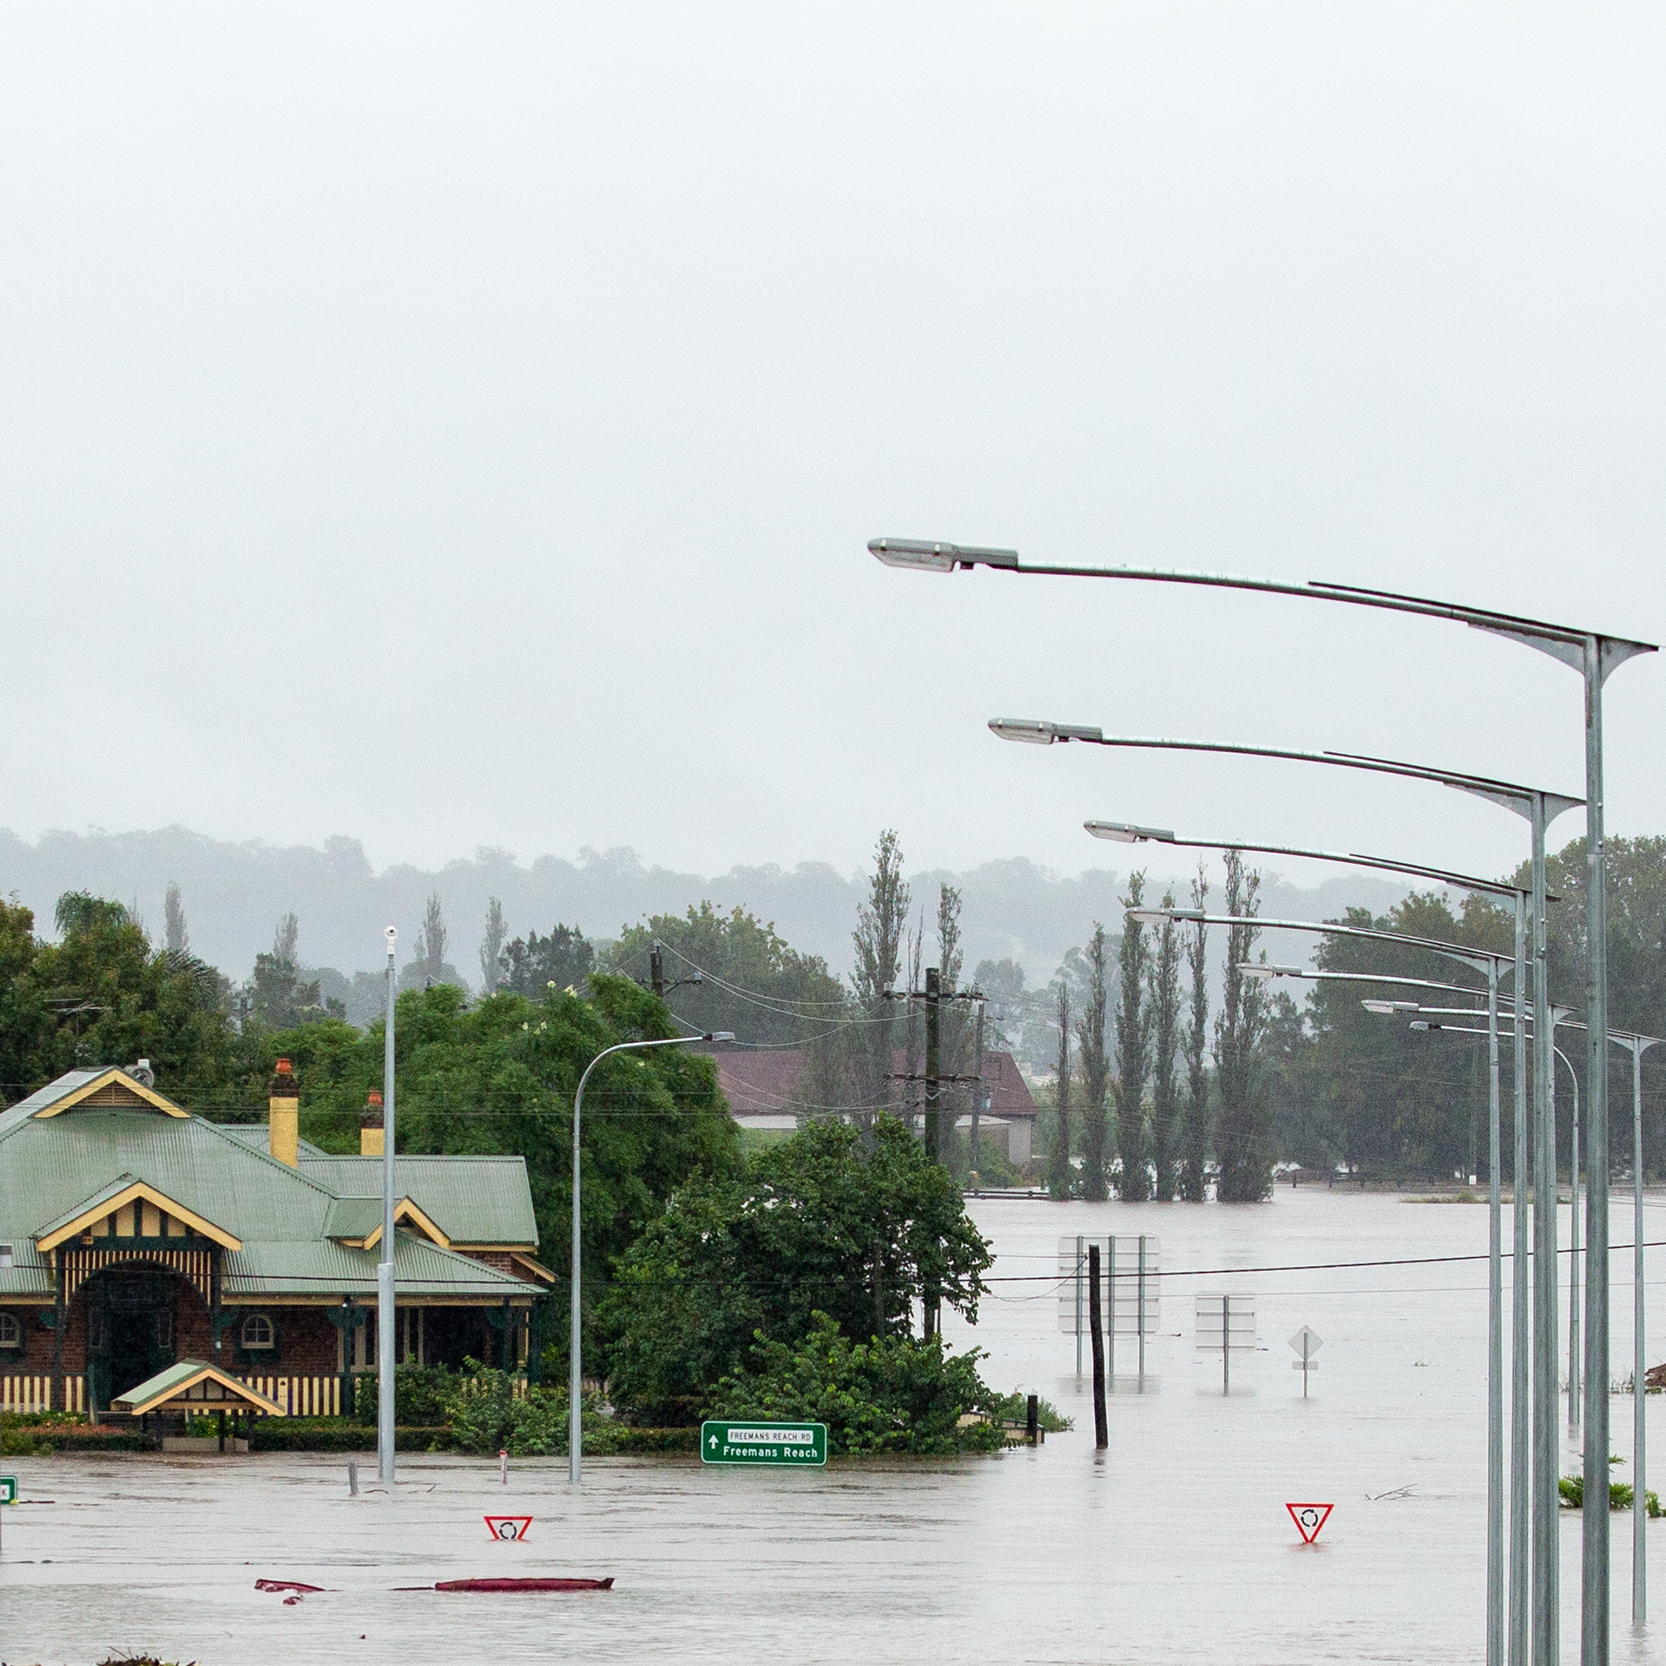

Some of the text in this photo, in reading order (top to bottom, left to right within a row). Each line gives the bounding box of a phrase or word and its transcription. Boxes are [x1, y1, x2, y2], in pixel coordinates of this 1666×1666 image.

[730, 1432, 811, 1442] FREEMANS REACH RD
[723, 1446, 818, 1458] Freemans Reach
